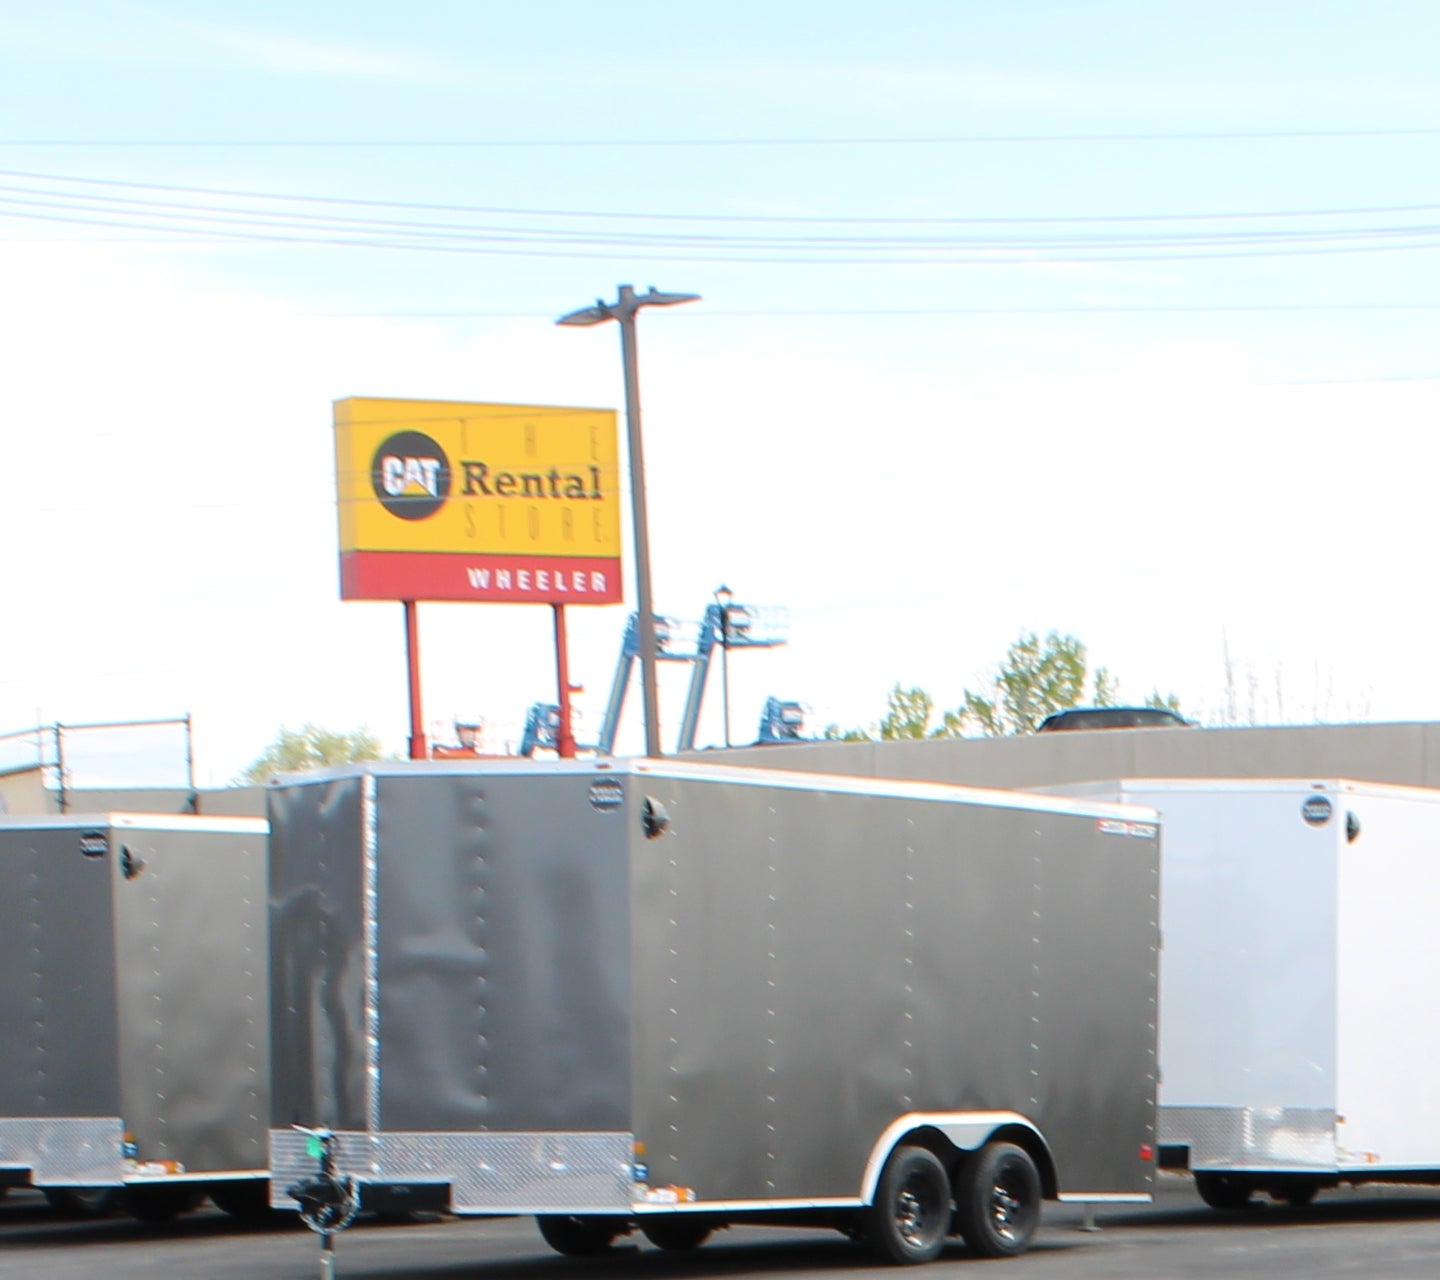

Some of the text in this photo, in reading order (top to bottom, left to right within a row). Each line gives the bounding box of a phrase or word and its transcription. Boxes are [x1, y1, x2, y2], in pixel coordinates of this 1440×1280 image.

[381, 455, 441, 497] CAT
[459, 460, 605, 501] Rental
[466, 565, 607, 592] WHEELER
